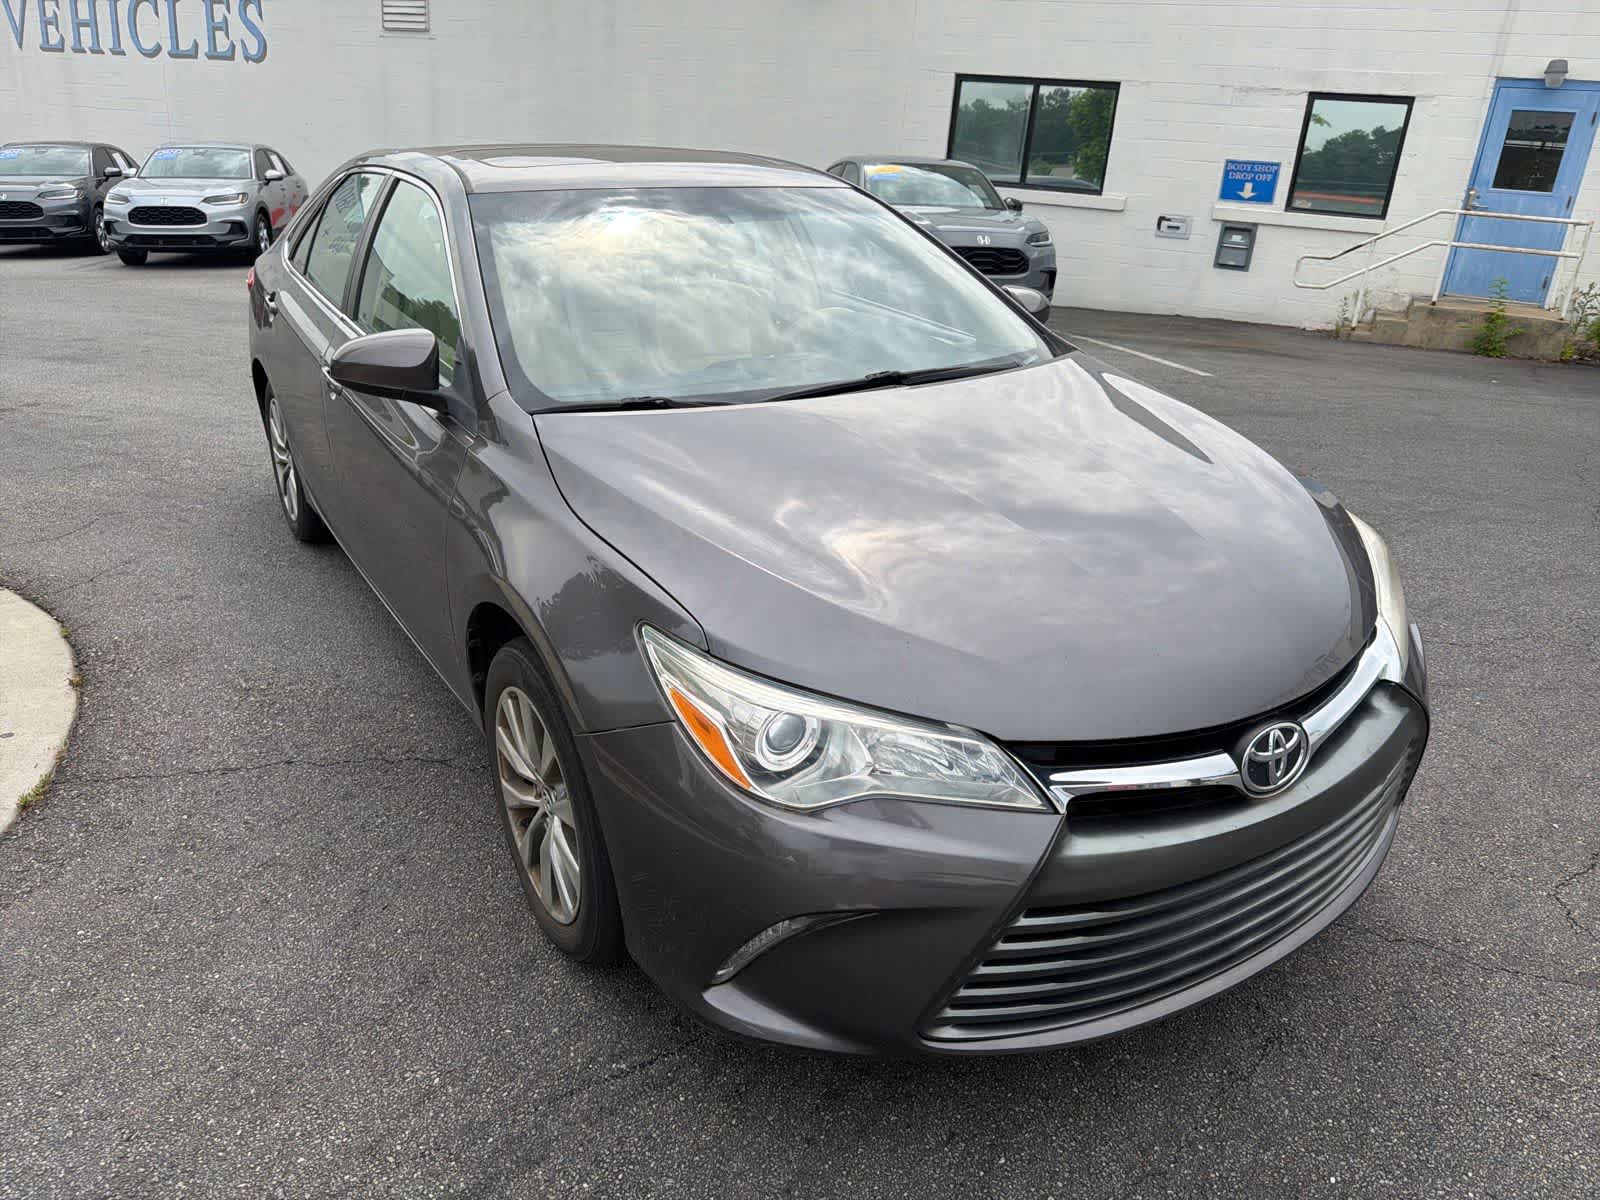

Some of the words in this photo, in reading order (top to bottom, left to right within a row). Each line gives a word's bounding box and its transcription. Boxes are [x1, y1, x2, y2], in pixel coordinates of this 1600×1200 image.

[2, 0, 267, 63] VEHICLES
[1227, 162, 1252, 171] BODY
[1252, 164, 1278, 173] SHOP
[1228, 171, 1254, 180] DROP
[1255, 173, 1273, 182] OFF
